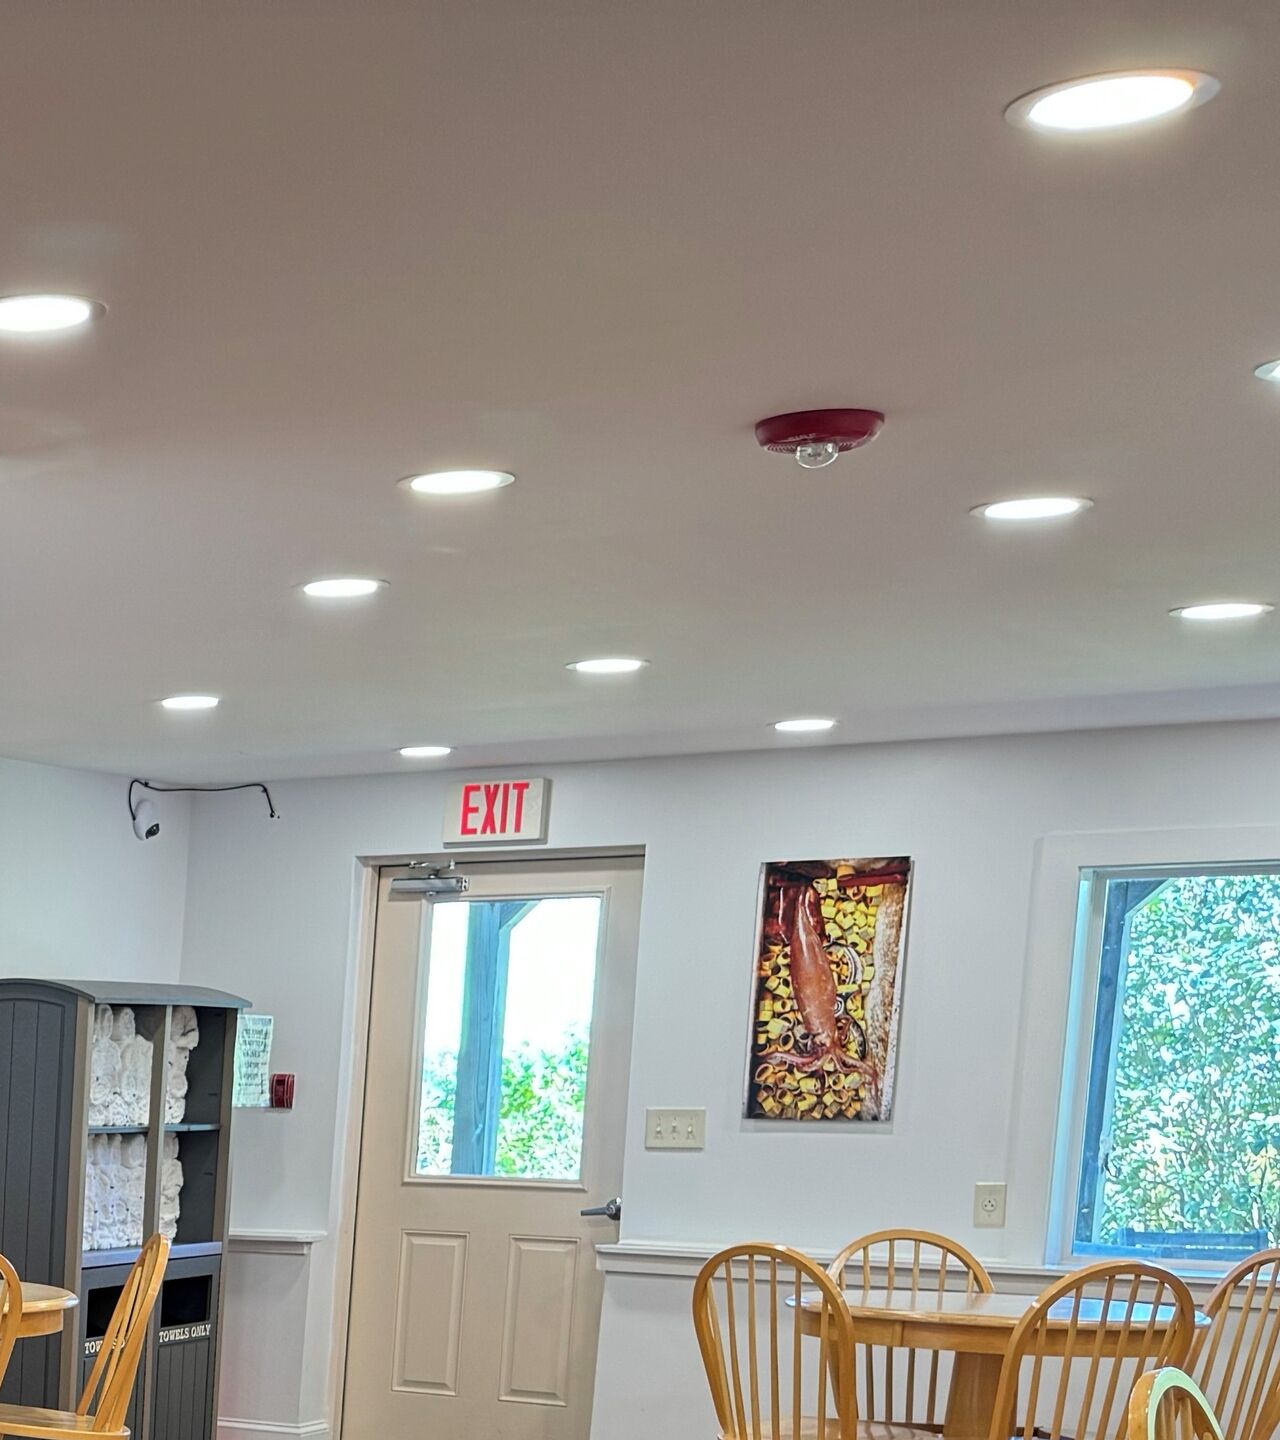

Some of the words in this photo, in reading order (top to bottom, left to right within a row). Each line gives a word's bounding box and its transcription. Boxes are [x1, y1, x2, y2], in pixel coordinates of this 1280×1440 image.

[460, 782, 530, 836] EXIT
[158, 1327, 190, 1343] TOWELS
[191, 1323, 211, 1338] ONLY
